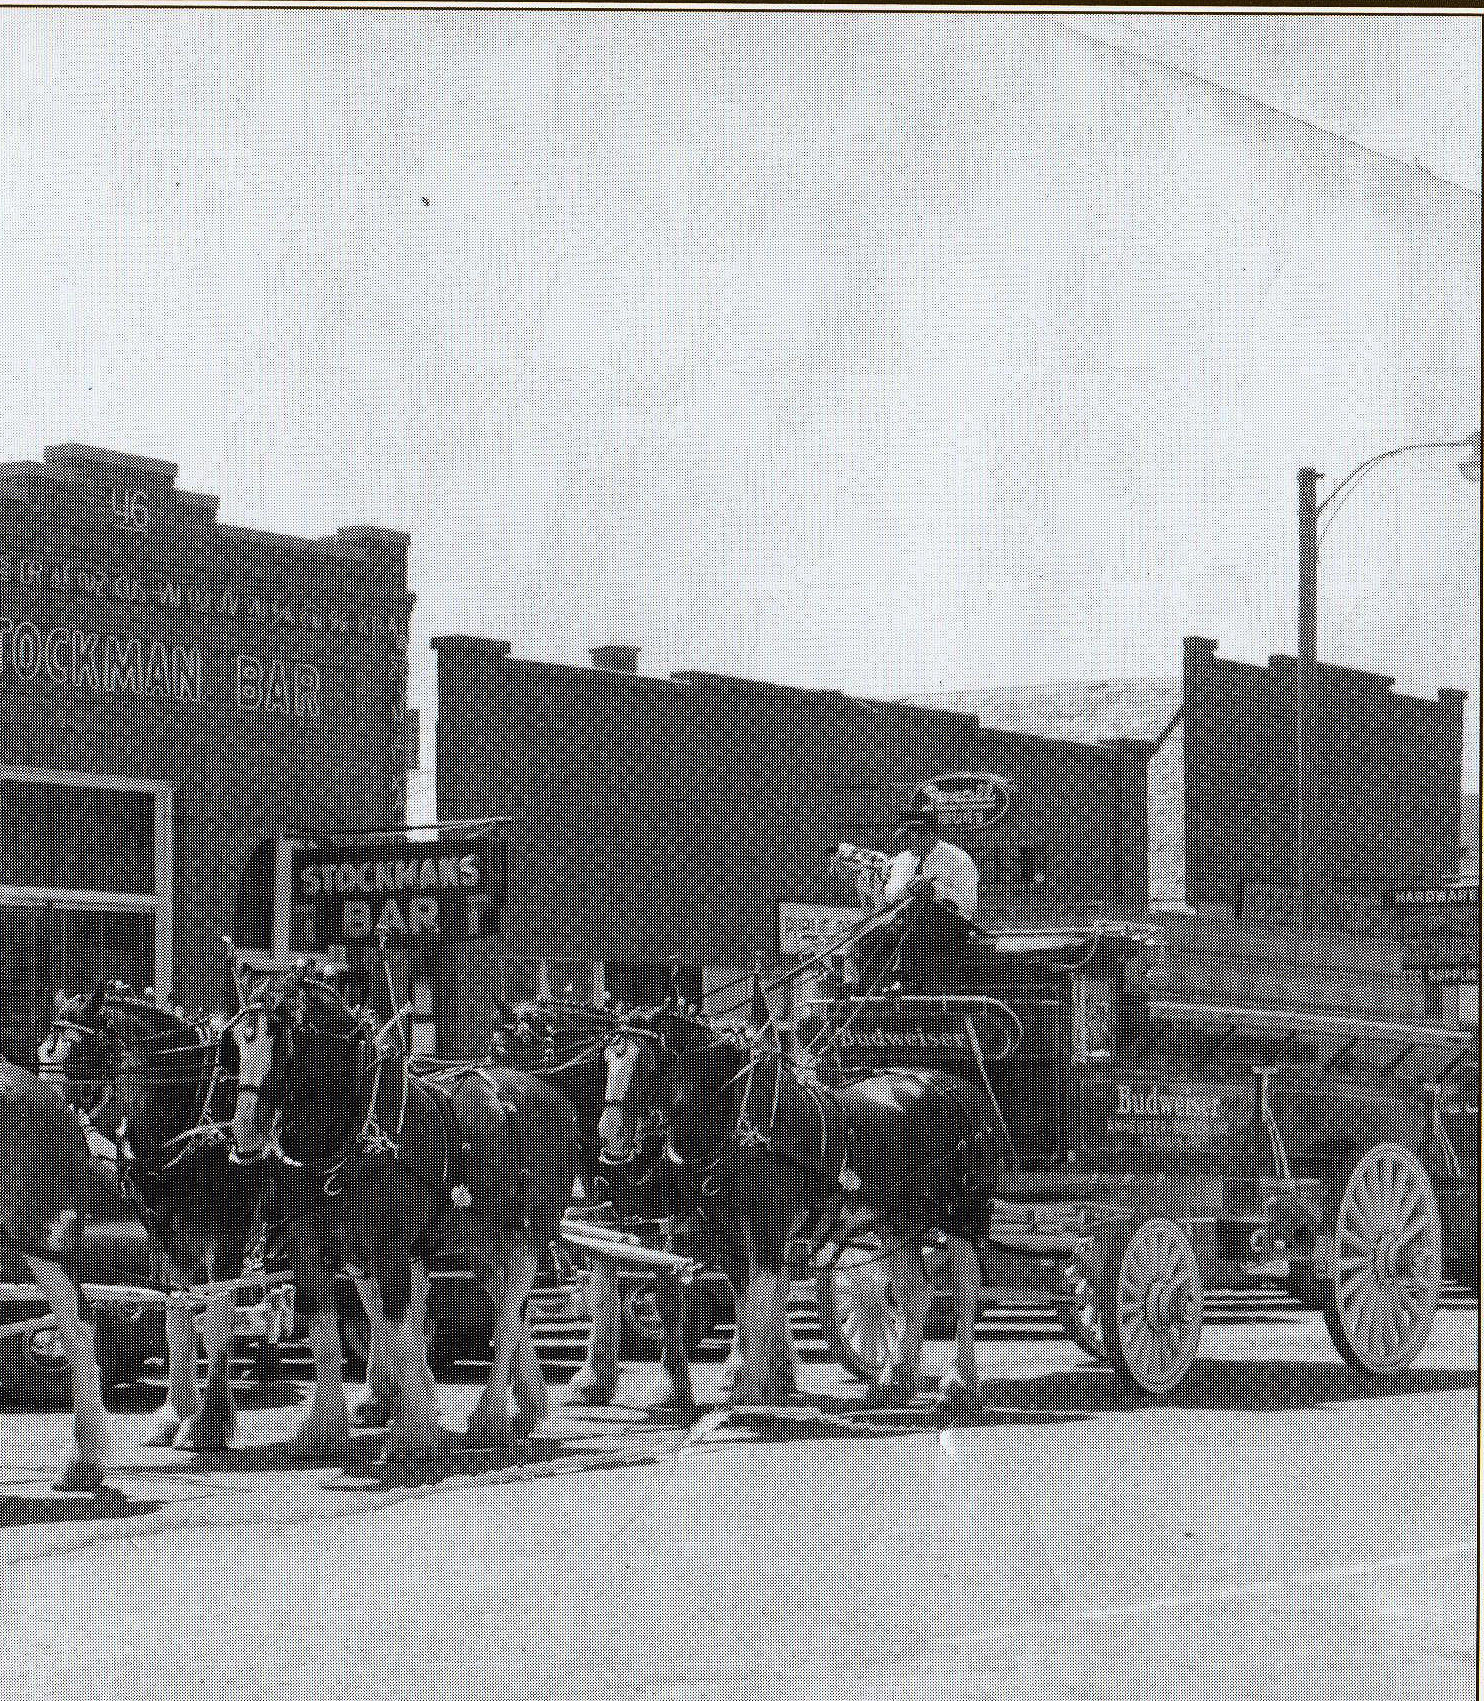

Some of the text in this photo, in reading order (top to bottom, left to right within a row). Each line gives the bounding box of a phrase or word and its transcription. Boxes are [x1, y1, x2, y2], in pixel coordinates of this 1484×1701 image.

[110, 488, 150, 530] 46
[235, 653, 322, 717] BAR
[300, 853, 480, 895] STOCKMANS
[342, 896, 441, 938] BAR
[839, 1026, 965, 1047] Budweiser
[1116, 1083, 1221, 1117] Budweiser
